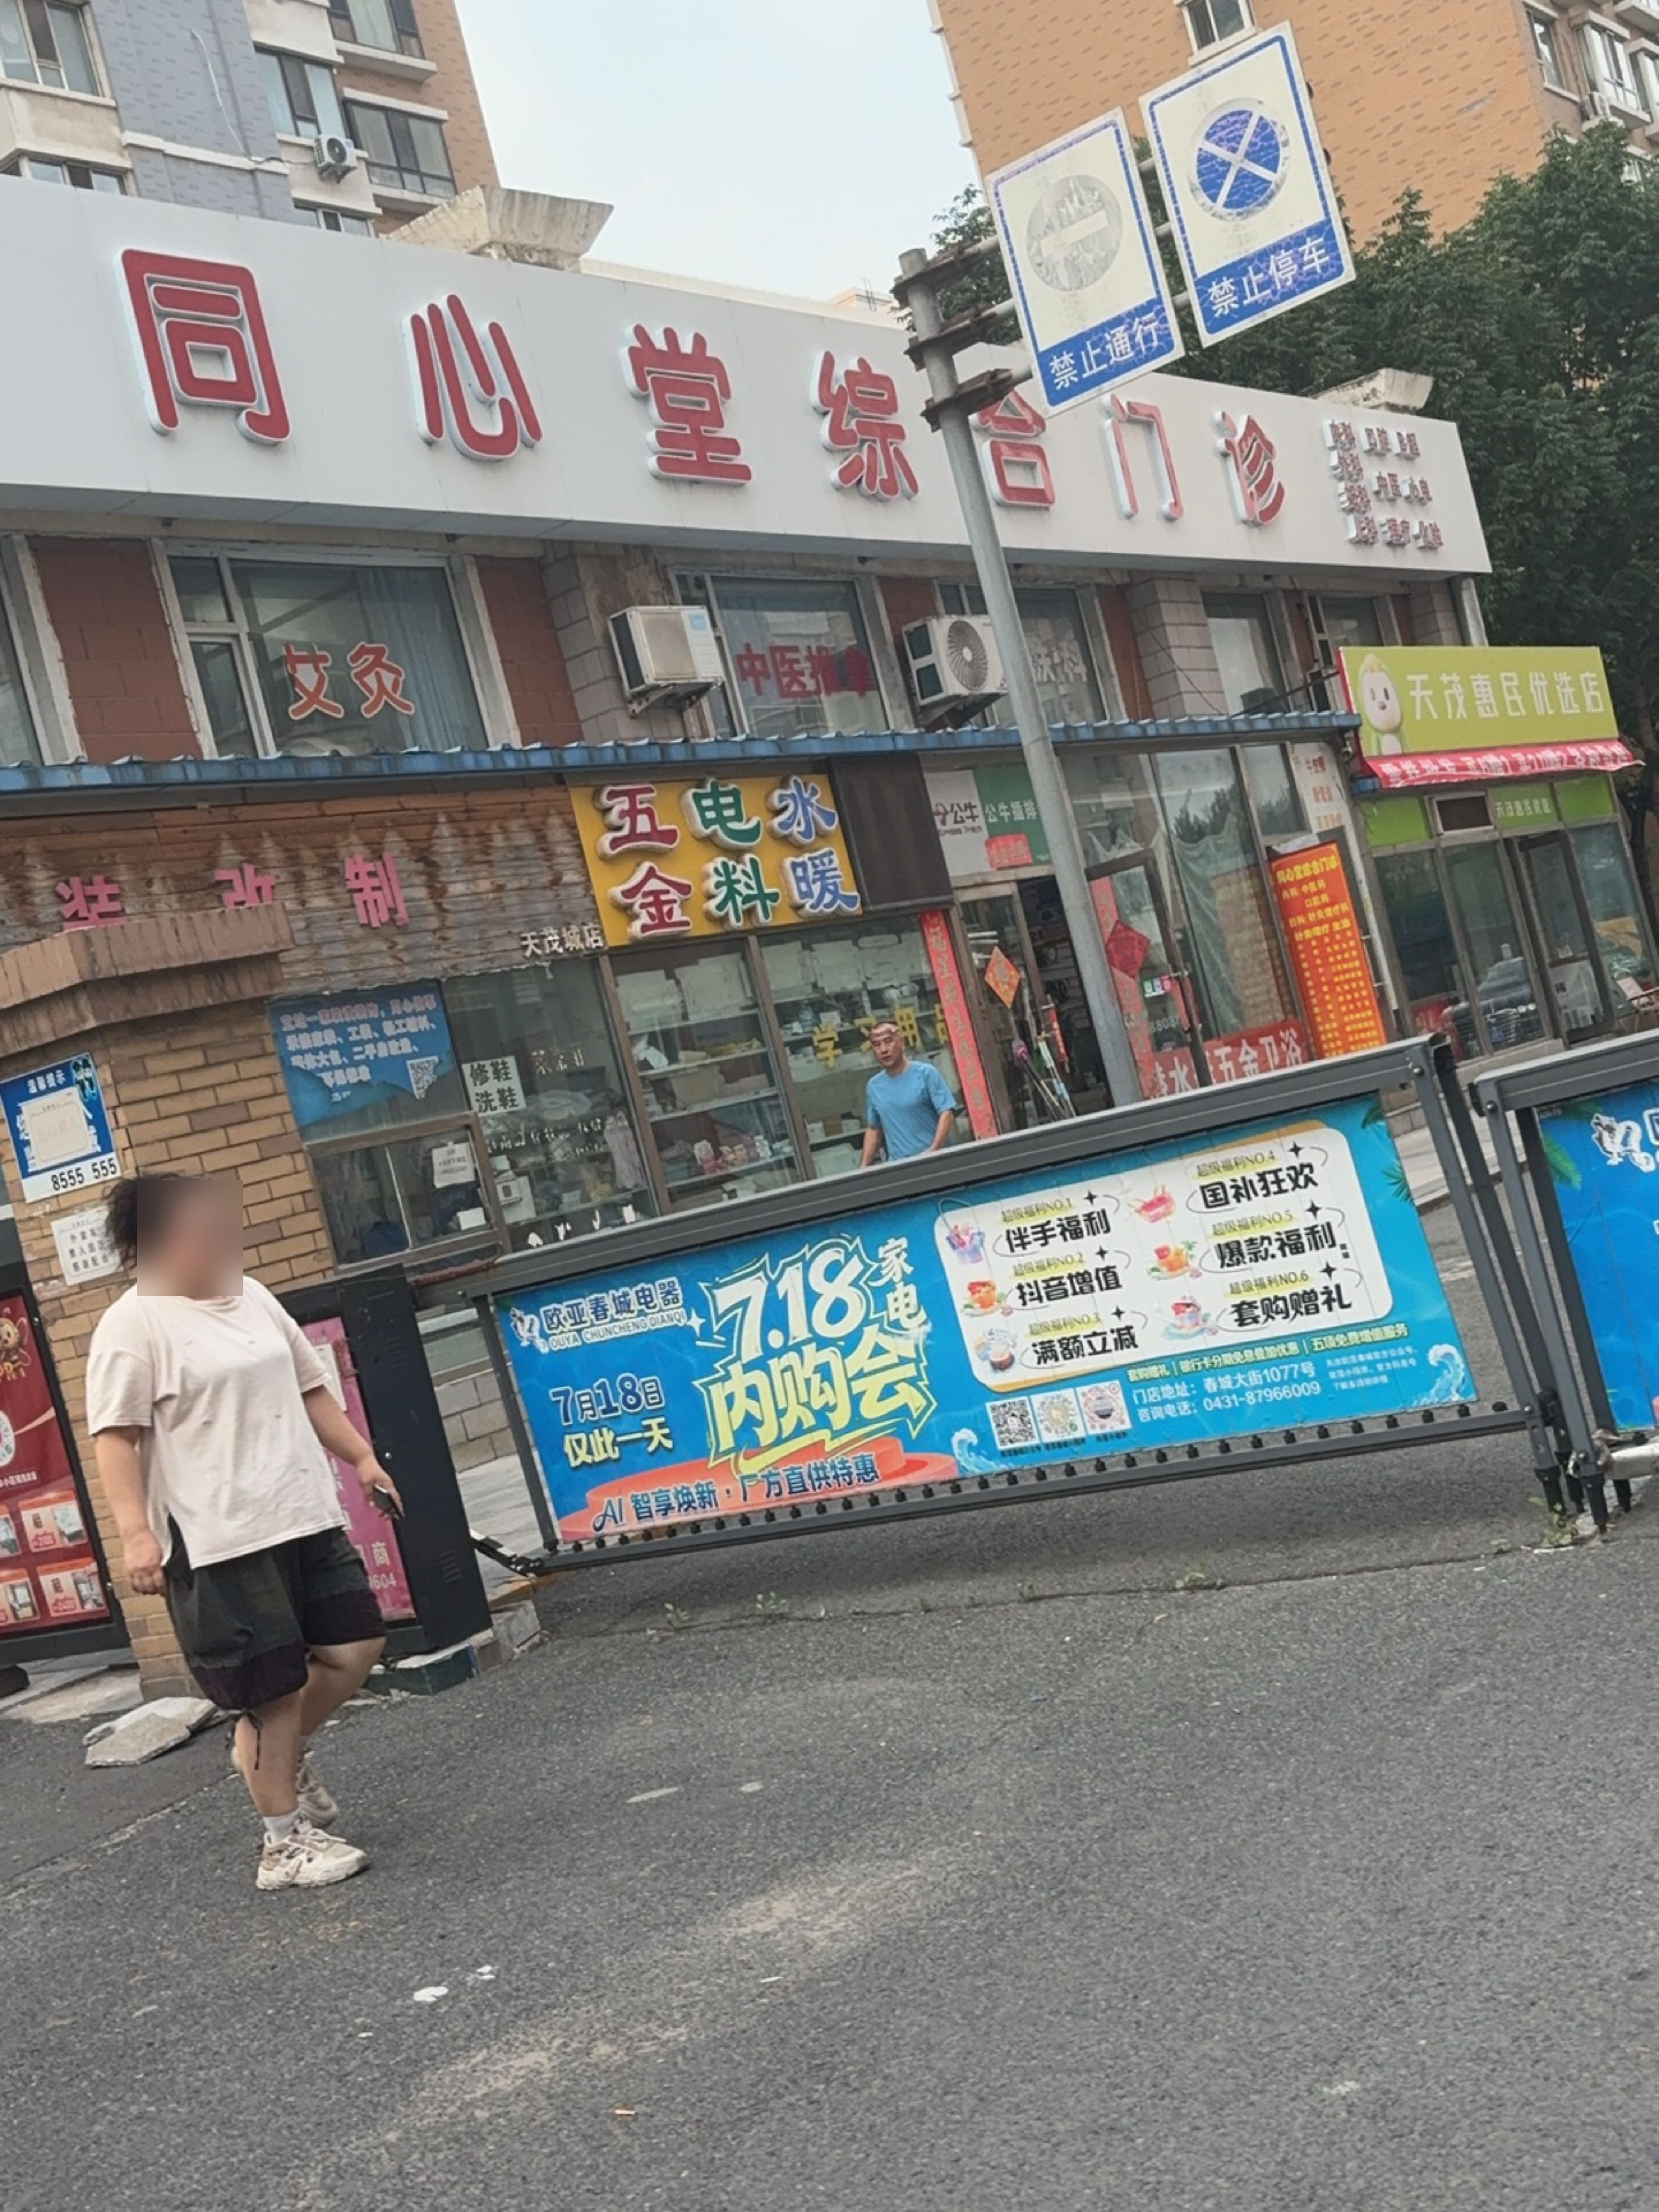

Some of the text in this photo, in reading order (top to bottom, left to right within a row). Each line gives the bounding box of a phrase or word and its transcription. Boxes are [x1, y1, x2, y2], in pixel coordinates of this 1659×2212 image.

[1207, 237, 1331, 319] 禁止停车
[1048, 311, 1160, 390] 禁止通行
[117, 248, 1286, 525] 同心堂综合门诊
[283, 642, 415, 720] 艾灸
[1407, 671, 1604, 720] 天茂惠民优选店
[950, 801, 979, 824] 公牛
[520, 923, 604, 958] 天茂城店
[469, 1059, 513, 1087] 修鞋
[475, 1086, 519, 1113] 洗鞋
[51, 1157, 117, 1191] 8555 555
[1196, 1150, 1276, 1178] 超级福利NO.4
[1198, 1164, 1318, 1210] 国补狂欢
[1000, 1198, 1073, 1222] 超级福利NO.1
[1004, 1208, 1111, 1254] 伴手福利
[1212, 1210, 1294, 1237] 超级福利NO.5
[1013, 1253, 1084, 1278] 超级福利NO.2
[1216, 1221, 1336, 1269] 爆款福利
[878, 1238, 926, 1331] 家电
[1015, 1265, 1122, 1307] 抖音增值
[1229, 1269, 1310, 1297] 超级福利NO.6
[543, 1280, 682, 1332] 欧亚春城电器
[717, 1248, 864, 1365] 7.18
[1029, 1312, 1100, 1337] 超级福利NO.3
[1231, 1285, 1352, 1328] 套购赠礼
[549, 1334, 579, 1351] OUYA
[584, 1320, 648, 1343] CHUNCHENG
[1031, 1324, 1138, 1365] 满额立减
[550, 1375, 664, 1425] 7月18日
[709, 1326, 926, 1452] 内购会
[564, 1416, 674, 1468] 仅此一天
[593, 1498, 625, 1532] AI
